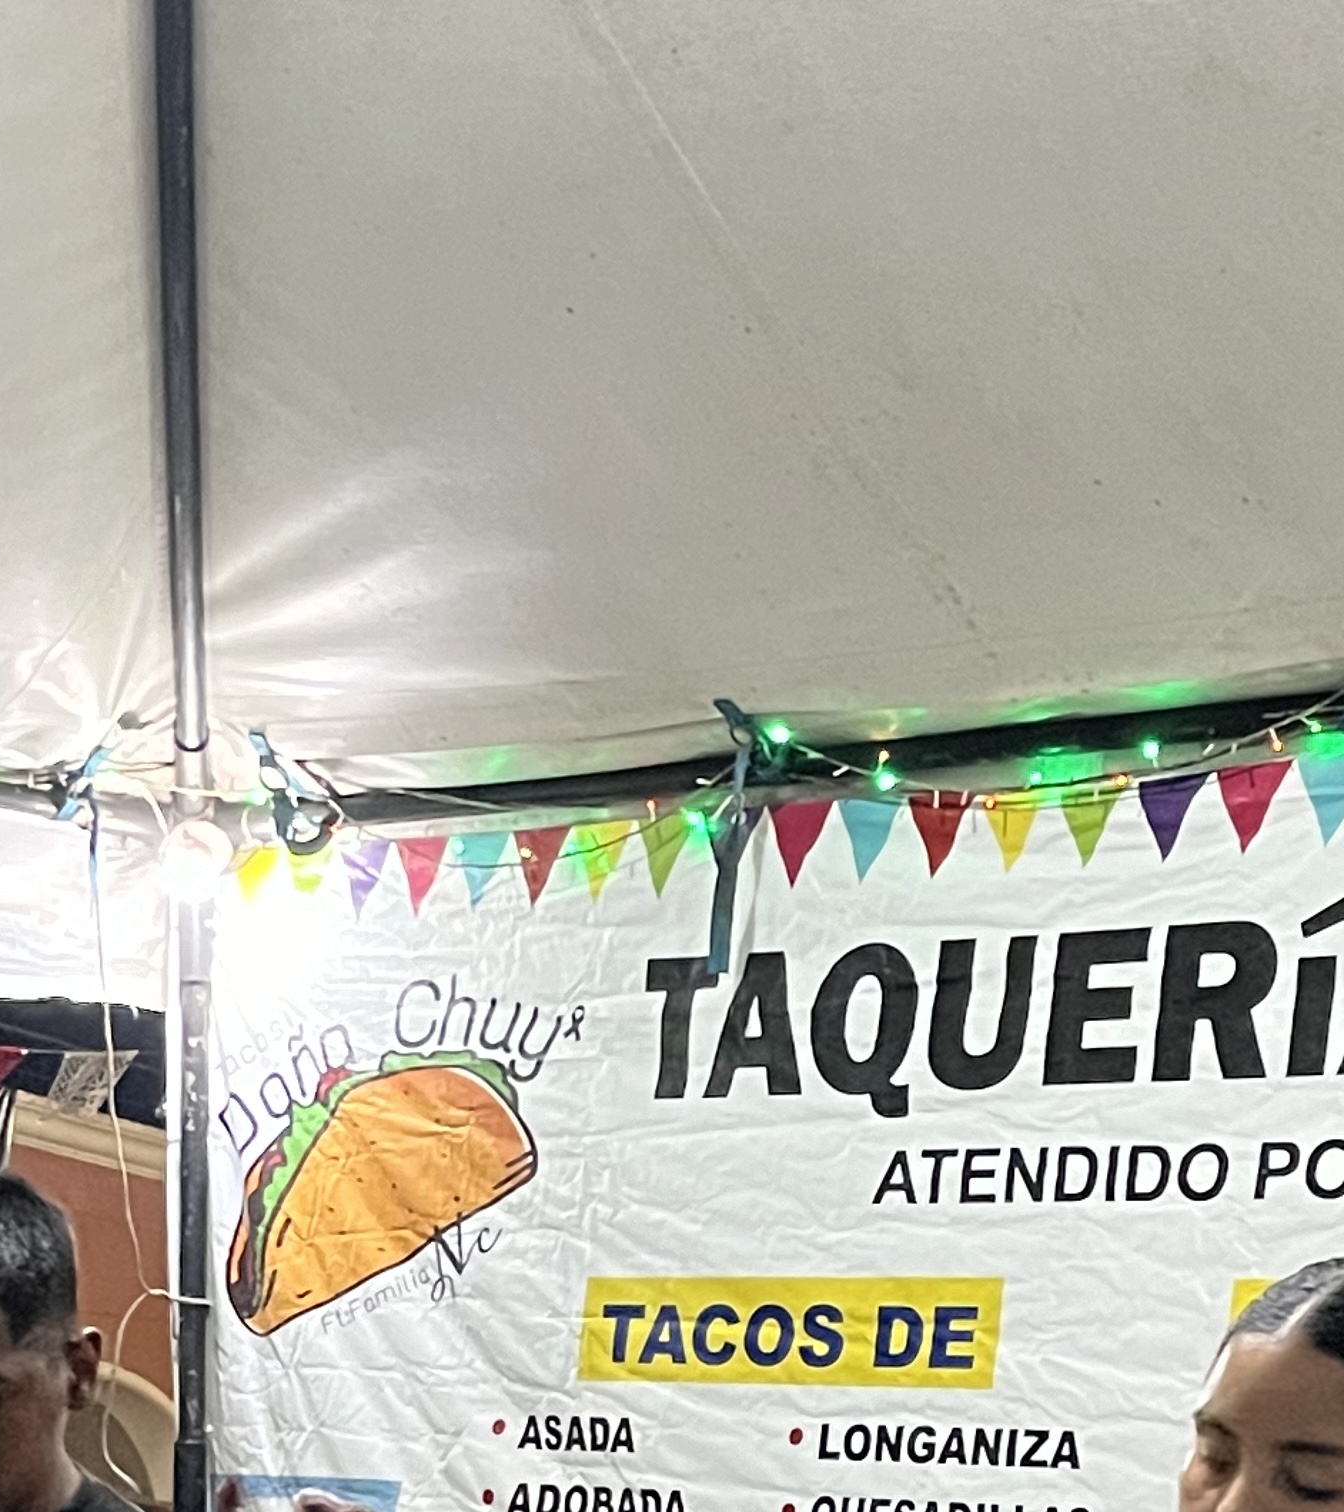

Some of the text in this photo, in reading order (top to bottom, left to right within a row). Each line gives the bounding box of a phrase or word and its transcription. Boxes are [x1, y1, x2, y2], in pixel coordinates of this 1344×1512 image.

[218, 974, 564, 1158] Doña Chuy
[874, 1142, 1229, 1204] ATENDIDO
[602, 1304, 979, 1369] TACOS DE
[517, 1415, 635, 1453] ASADA
[818, 1423, 1080, 1470] LONGANIZA
